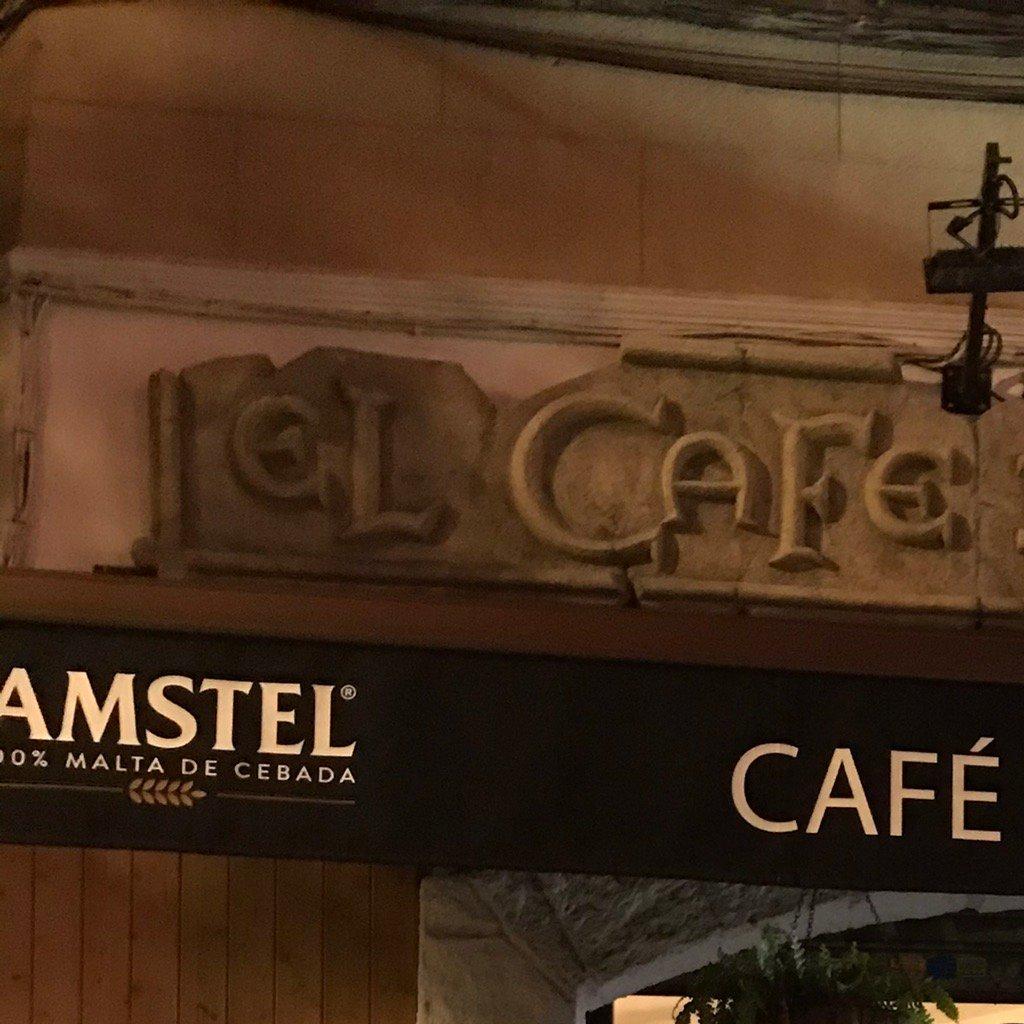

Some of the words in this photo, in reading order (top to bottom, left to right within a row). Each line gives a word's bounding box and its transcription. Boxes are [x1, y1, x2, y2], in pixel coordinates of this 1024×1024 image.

[0, 667, 356, 757] AMSTEL
[65, 752, 165, 774] MALTA
[181, 758, 218, 777] DE
[234, 762, 356, 784] CEBADA
[731, 736, 1001, 842] CAFÉ
